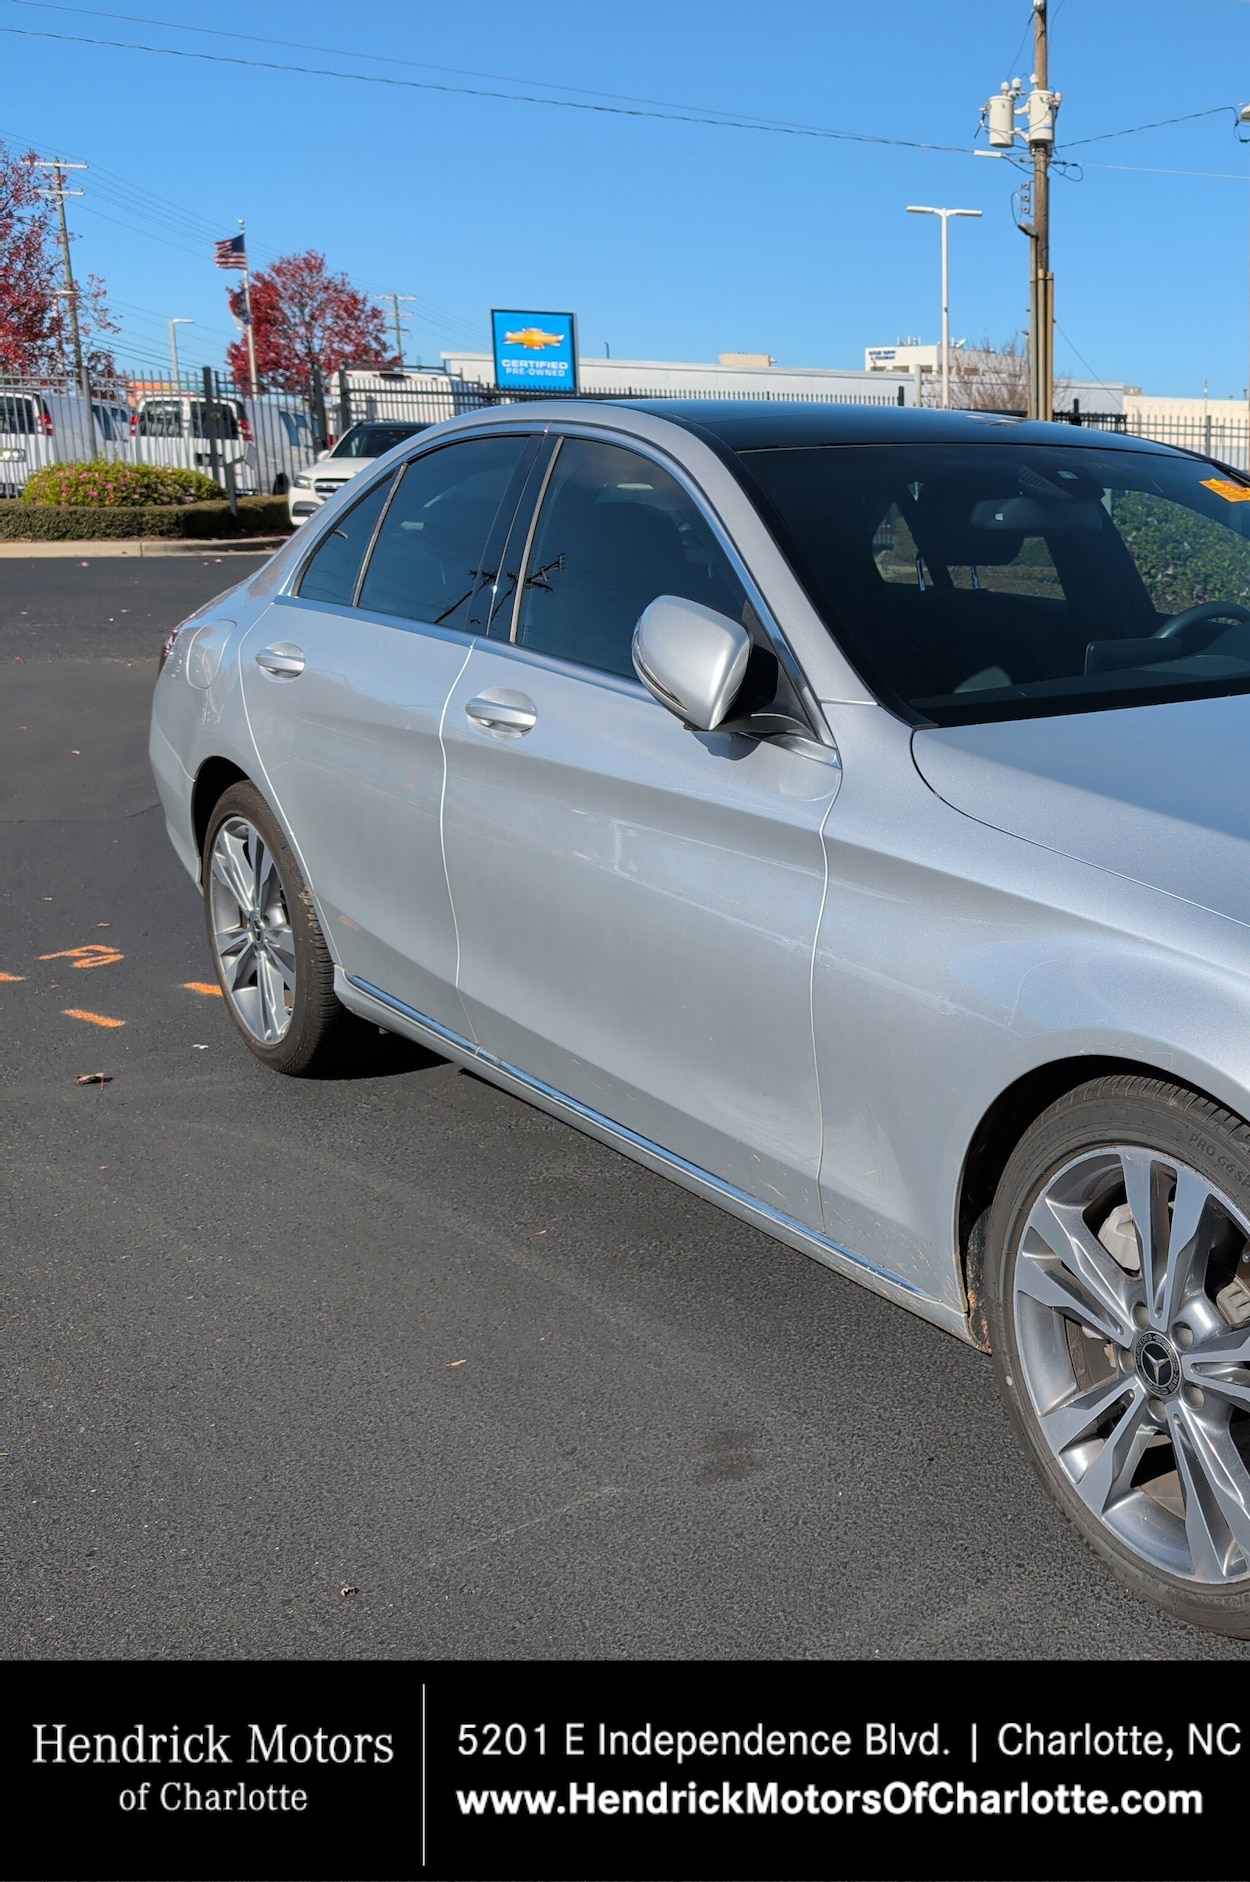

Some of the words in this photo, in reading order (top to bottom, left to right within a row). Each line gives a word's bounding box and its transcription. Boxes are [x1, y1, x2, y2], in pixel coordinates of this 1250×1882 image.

[501, 359, 569, 370] CERTIFIED
[506, 367, 566, 377] PRE-OWNED
[1189, 1131, 1217, 1158] PRO
